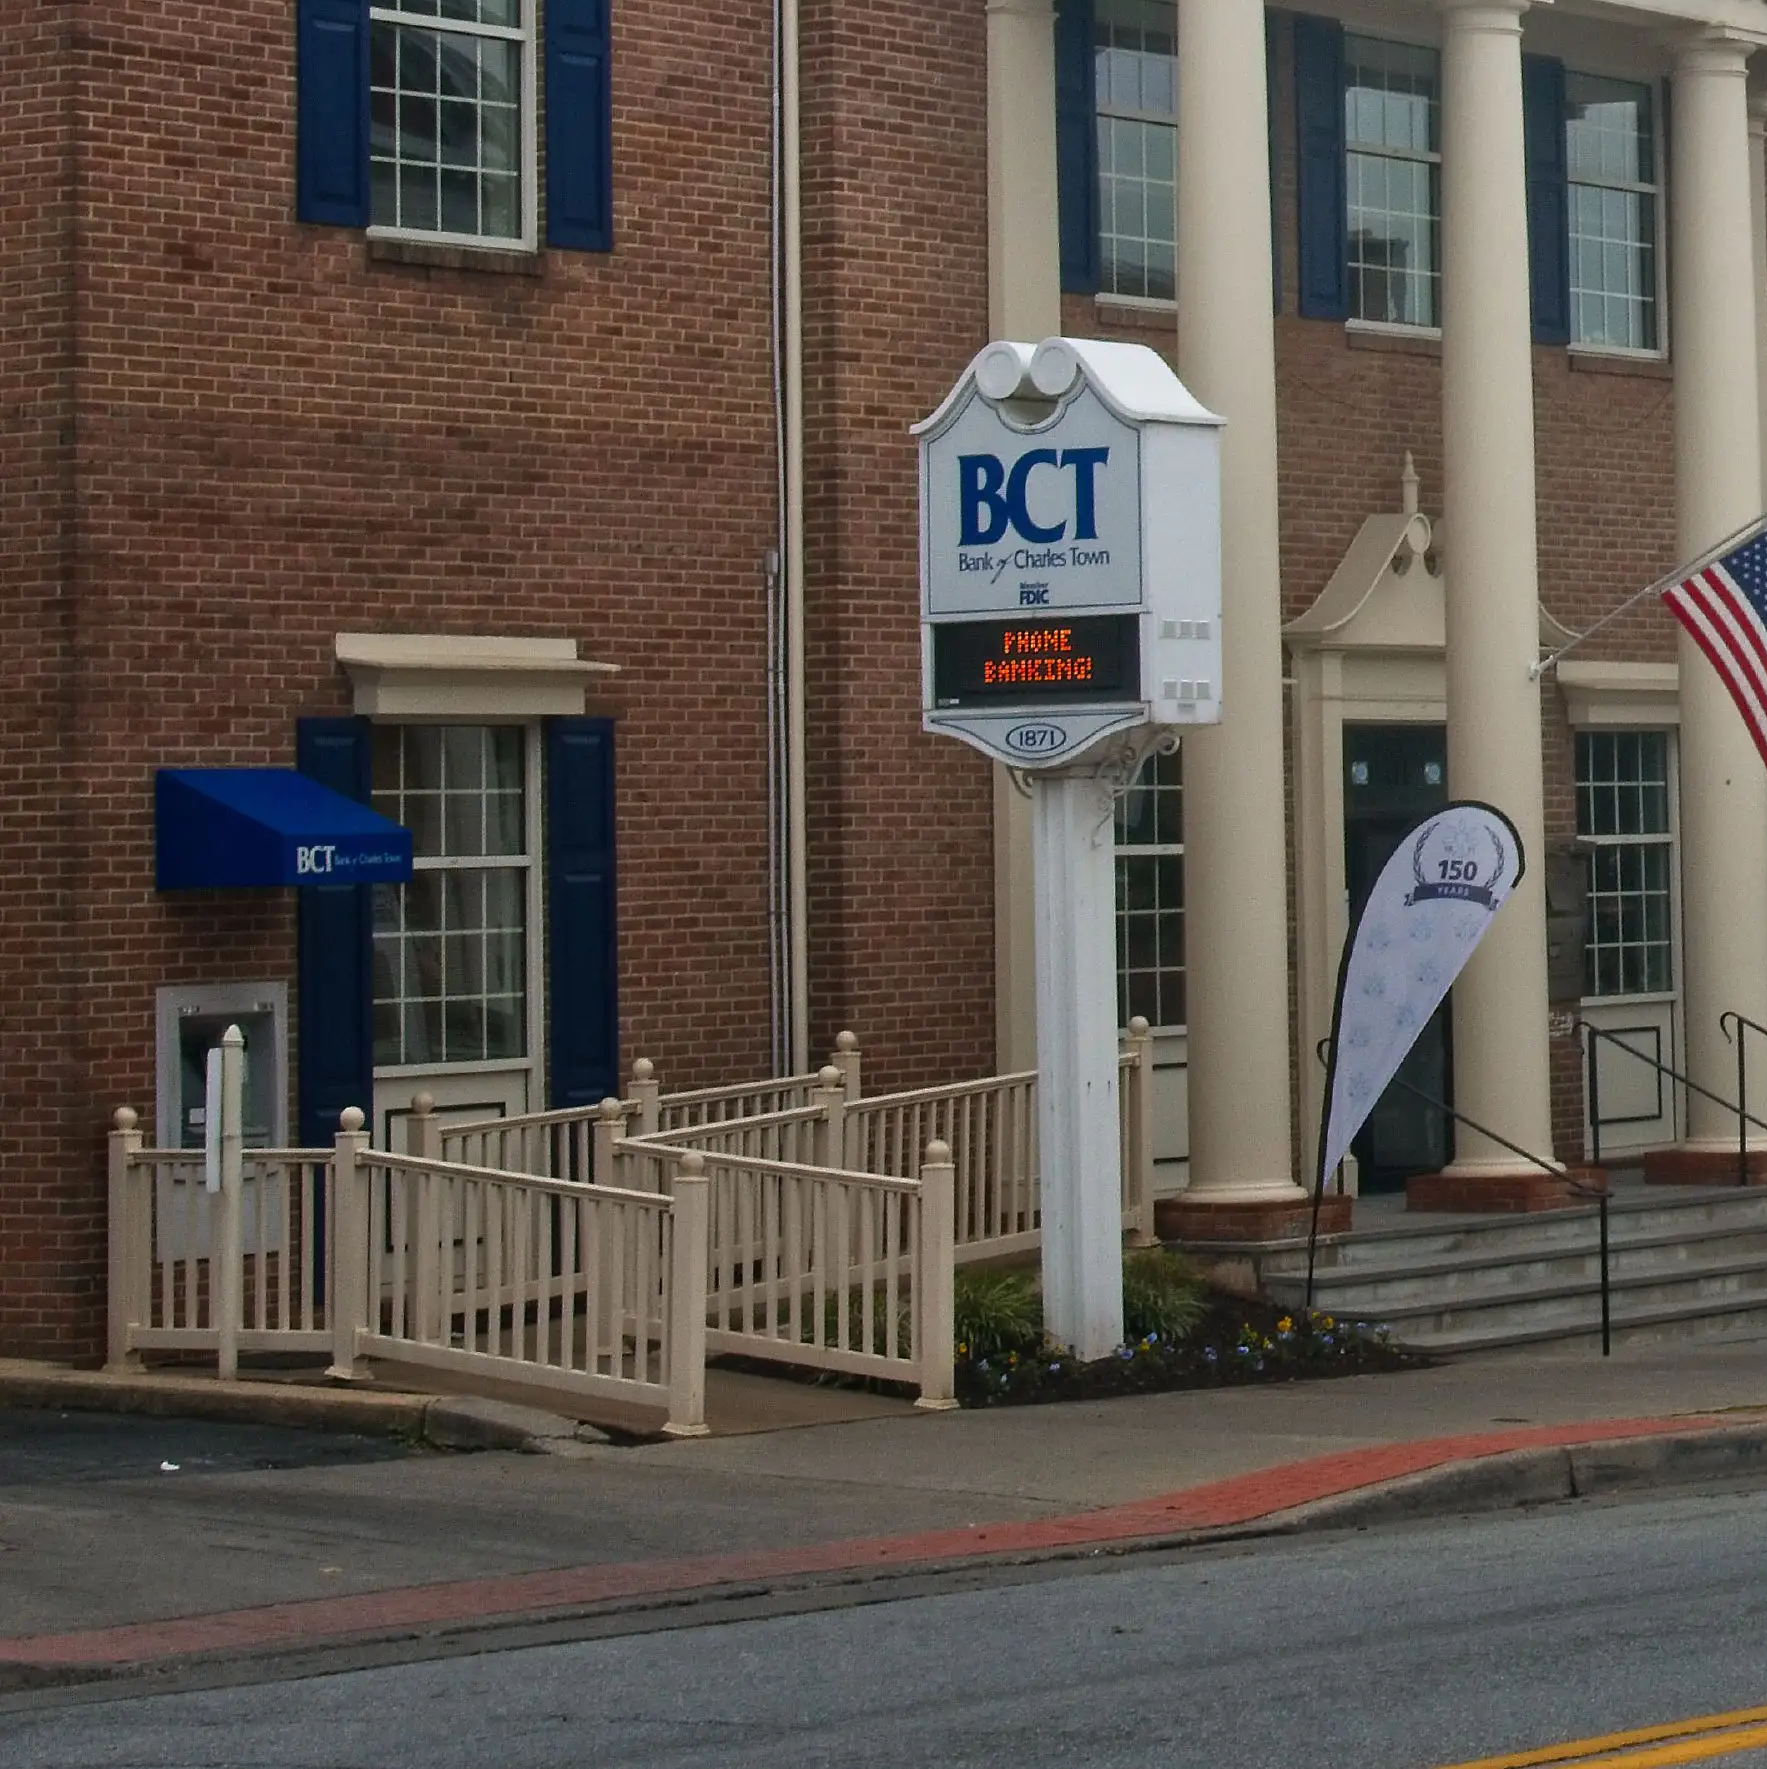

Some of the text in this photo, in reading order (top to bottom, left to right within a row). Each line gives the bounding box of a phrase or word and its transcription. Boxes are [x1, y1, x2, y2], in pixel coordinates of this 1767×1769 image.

[958, 447, 1110, 547] BCT
[959, 552, 993, 572] Bank
[1014, 548, 1066, 569] Charles
[1070, 547, 1110, 566] Town
[1020, 589, 1050, 606] FDIC
[1019, 730, 1055, 747] 1871
[296, 845, 336, 874] BCT
[1438, 860, 1478, 881] 150
